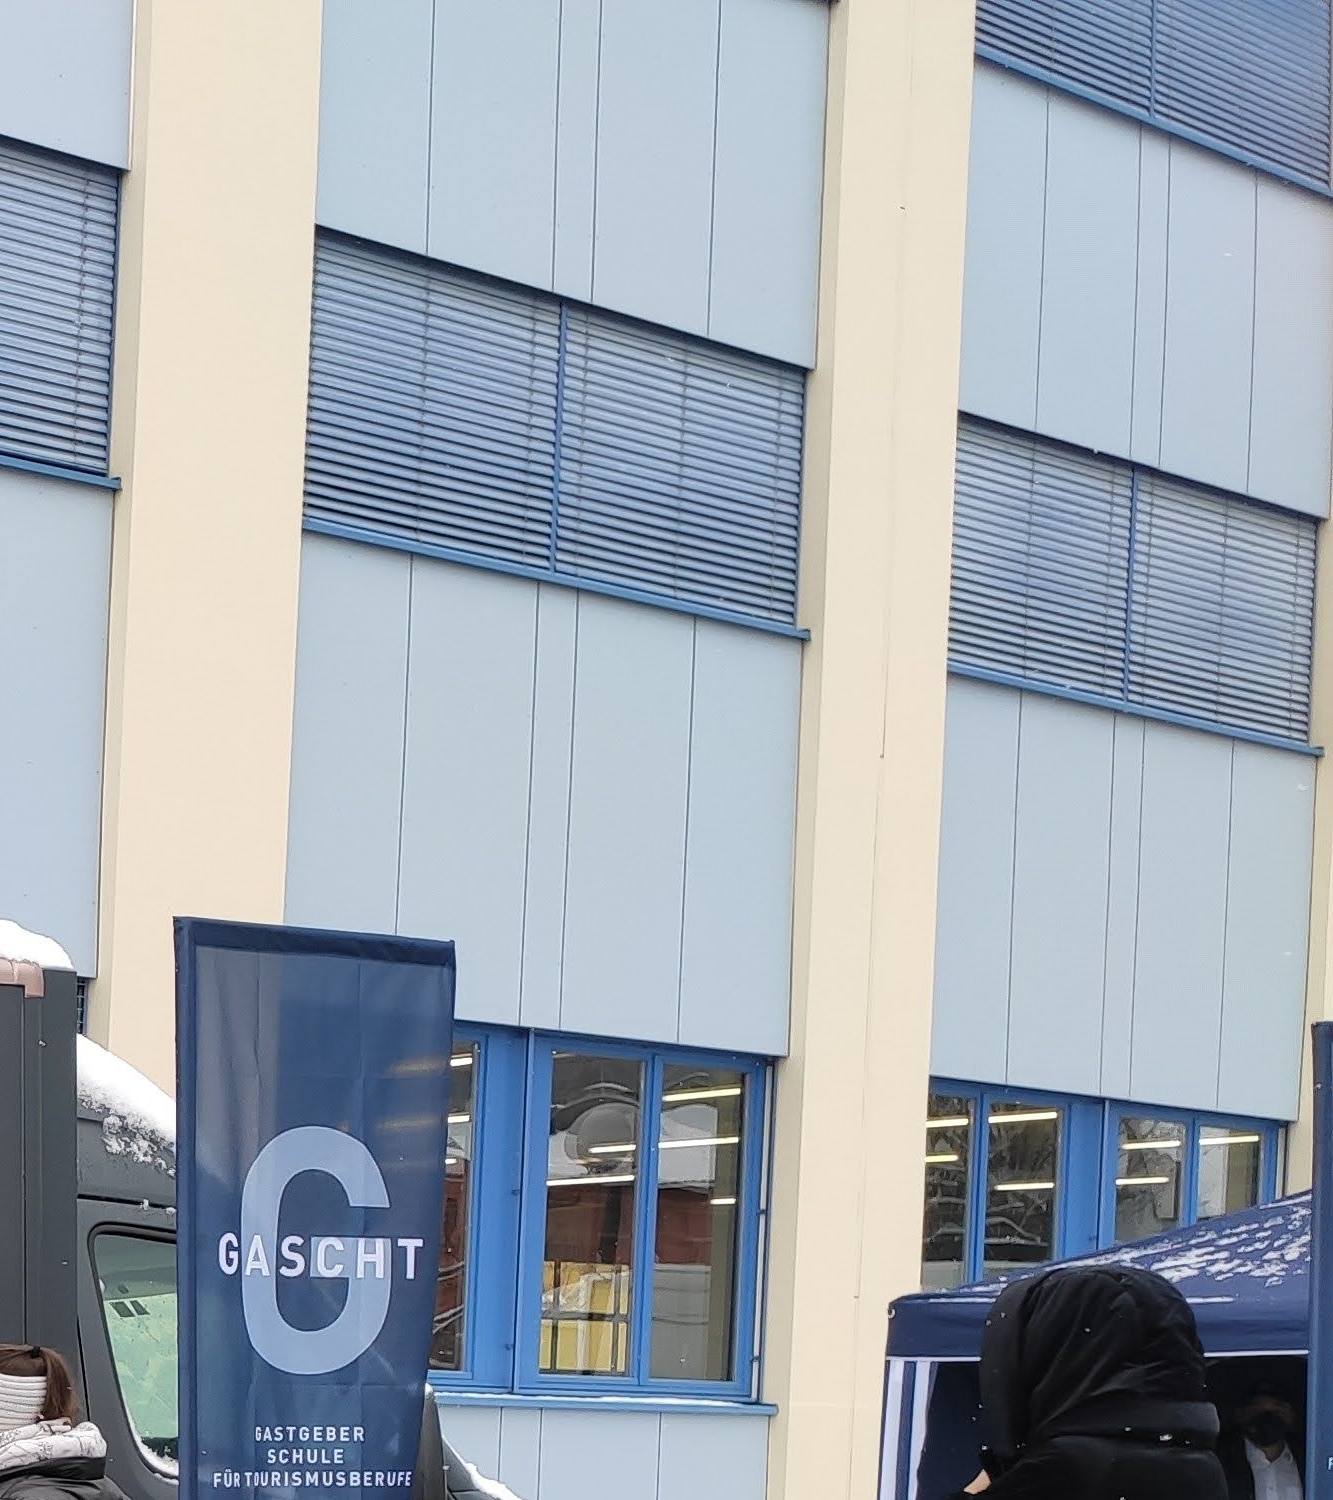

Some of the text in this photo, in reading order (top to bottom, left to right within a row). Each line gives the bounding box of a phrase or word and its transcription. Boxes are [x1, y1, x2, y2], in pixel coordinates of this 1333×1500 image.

[218, 1231, 424, 1280] GASCHT
[254, 1426, 365, 1442] GASTGEBER
[267, 1448, 345, 1465] SCHULE
[213, 1468, 413, 1488] FÜR TOURISMUSBERUFE
